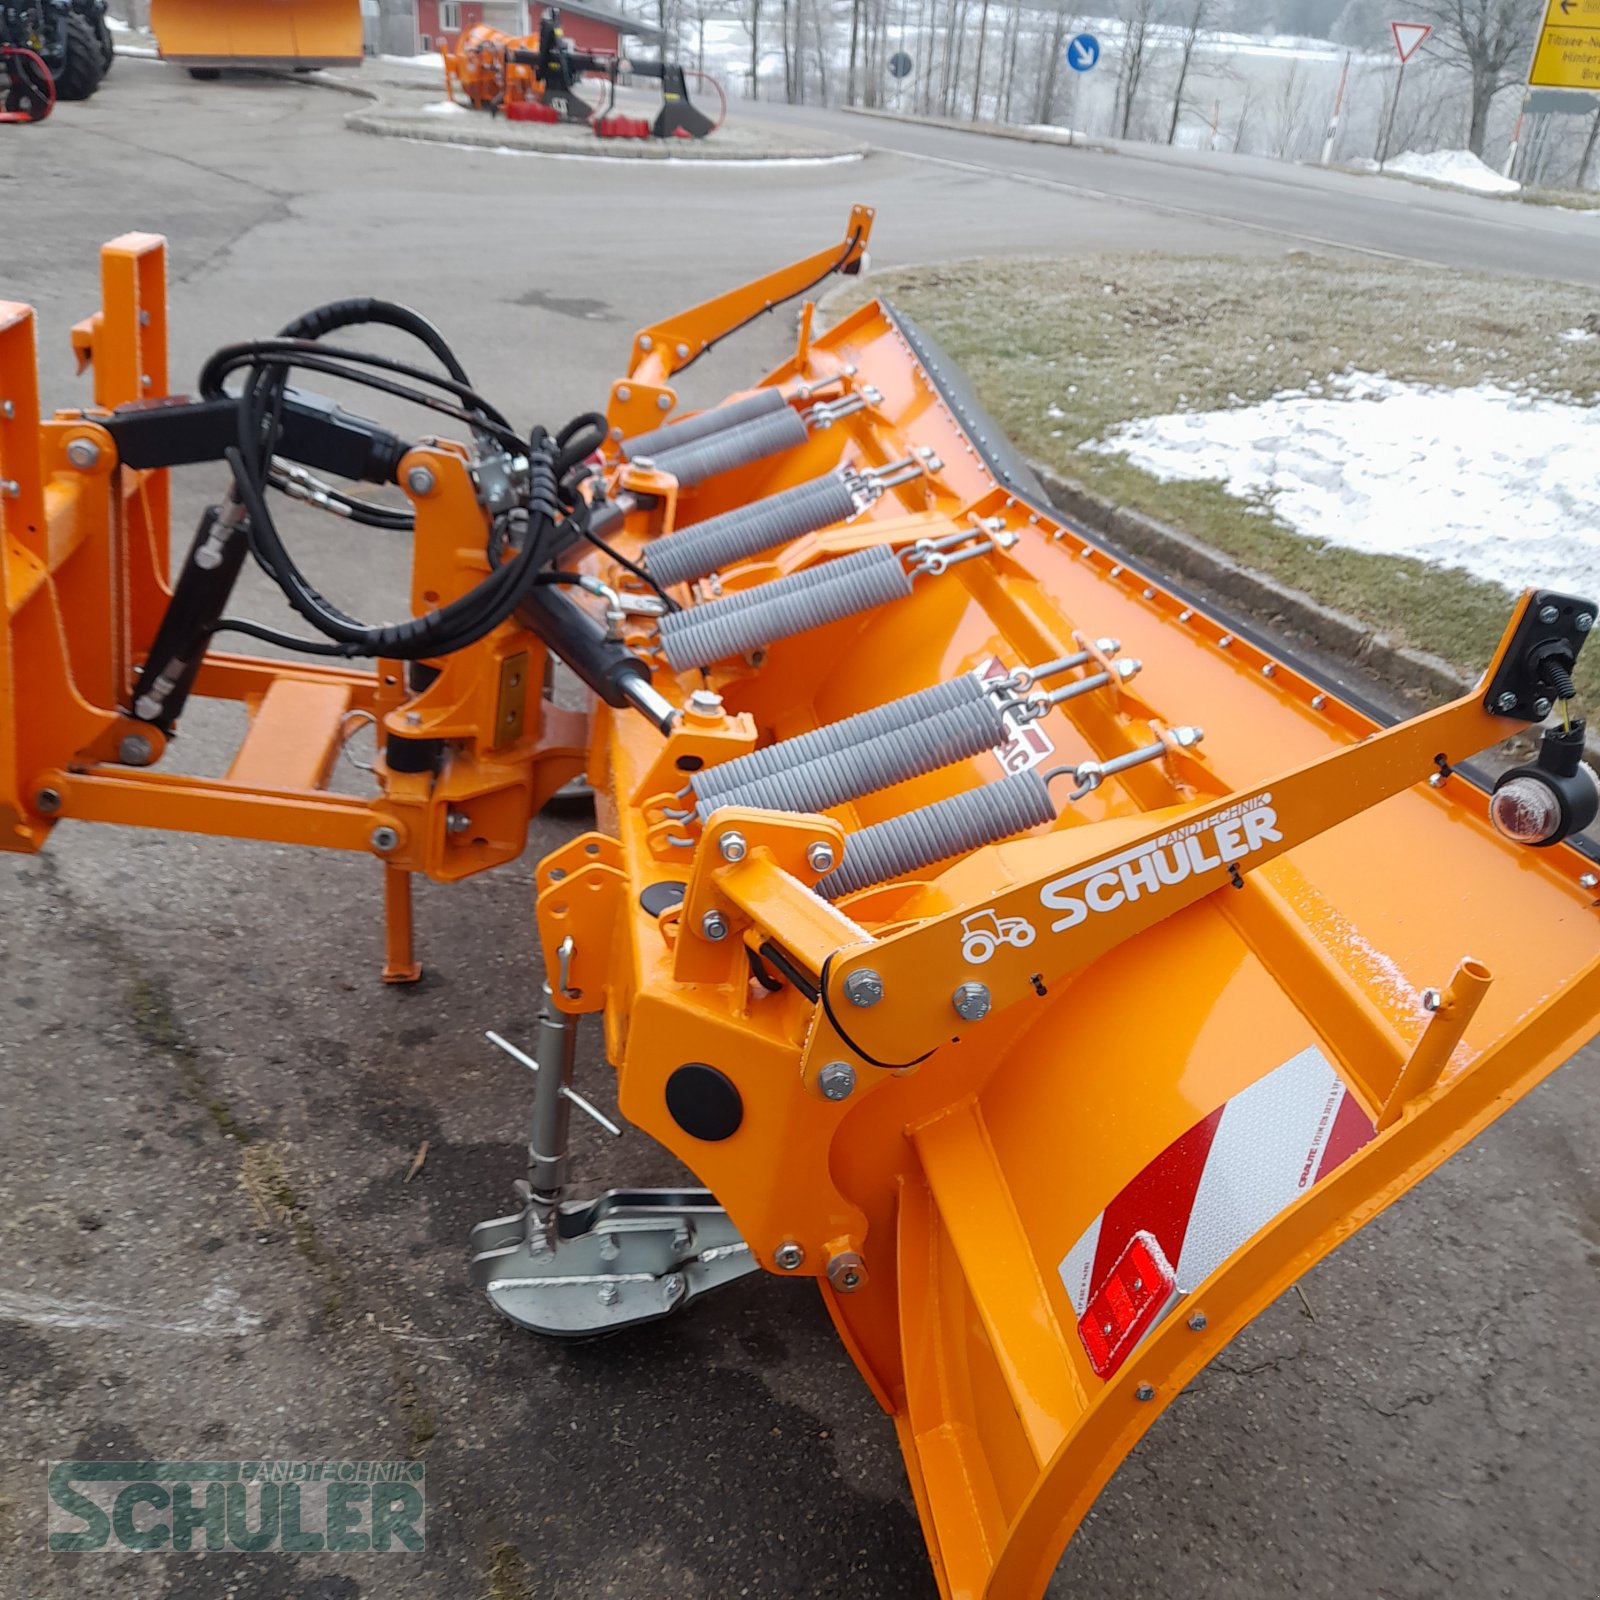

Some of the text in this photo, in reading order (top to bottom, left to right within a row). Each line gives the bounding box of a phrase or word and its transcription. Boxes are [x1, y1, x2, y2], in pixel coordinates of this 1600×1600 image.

[1156, 794, 1266, 848] LANDTECHNIK
[1040, 806, 1283, 933] SCHULER
[1298, 1148, 1318, 1188] ORALITE
